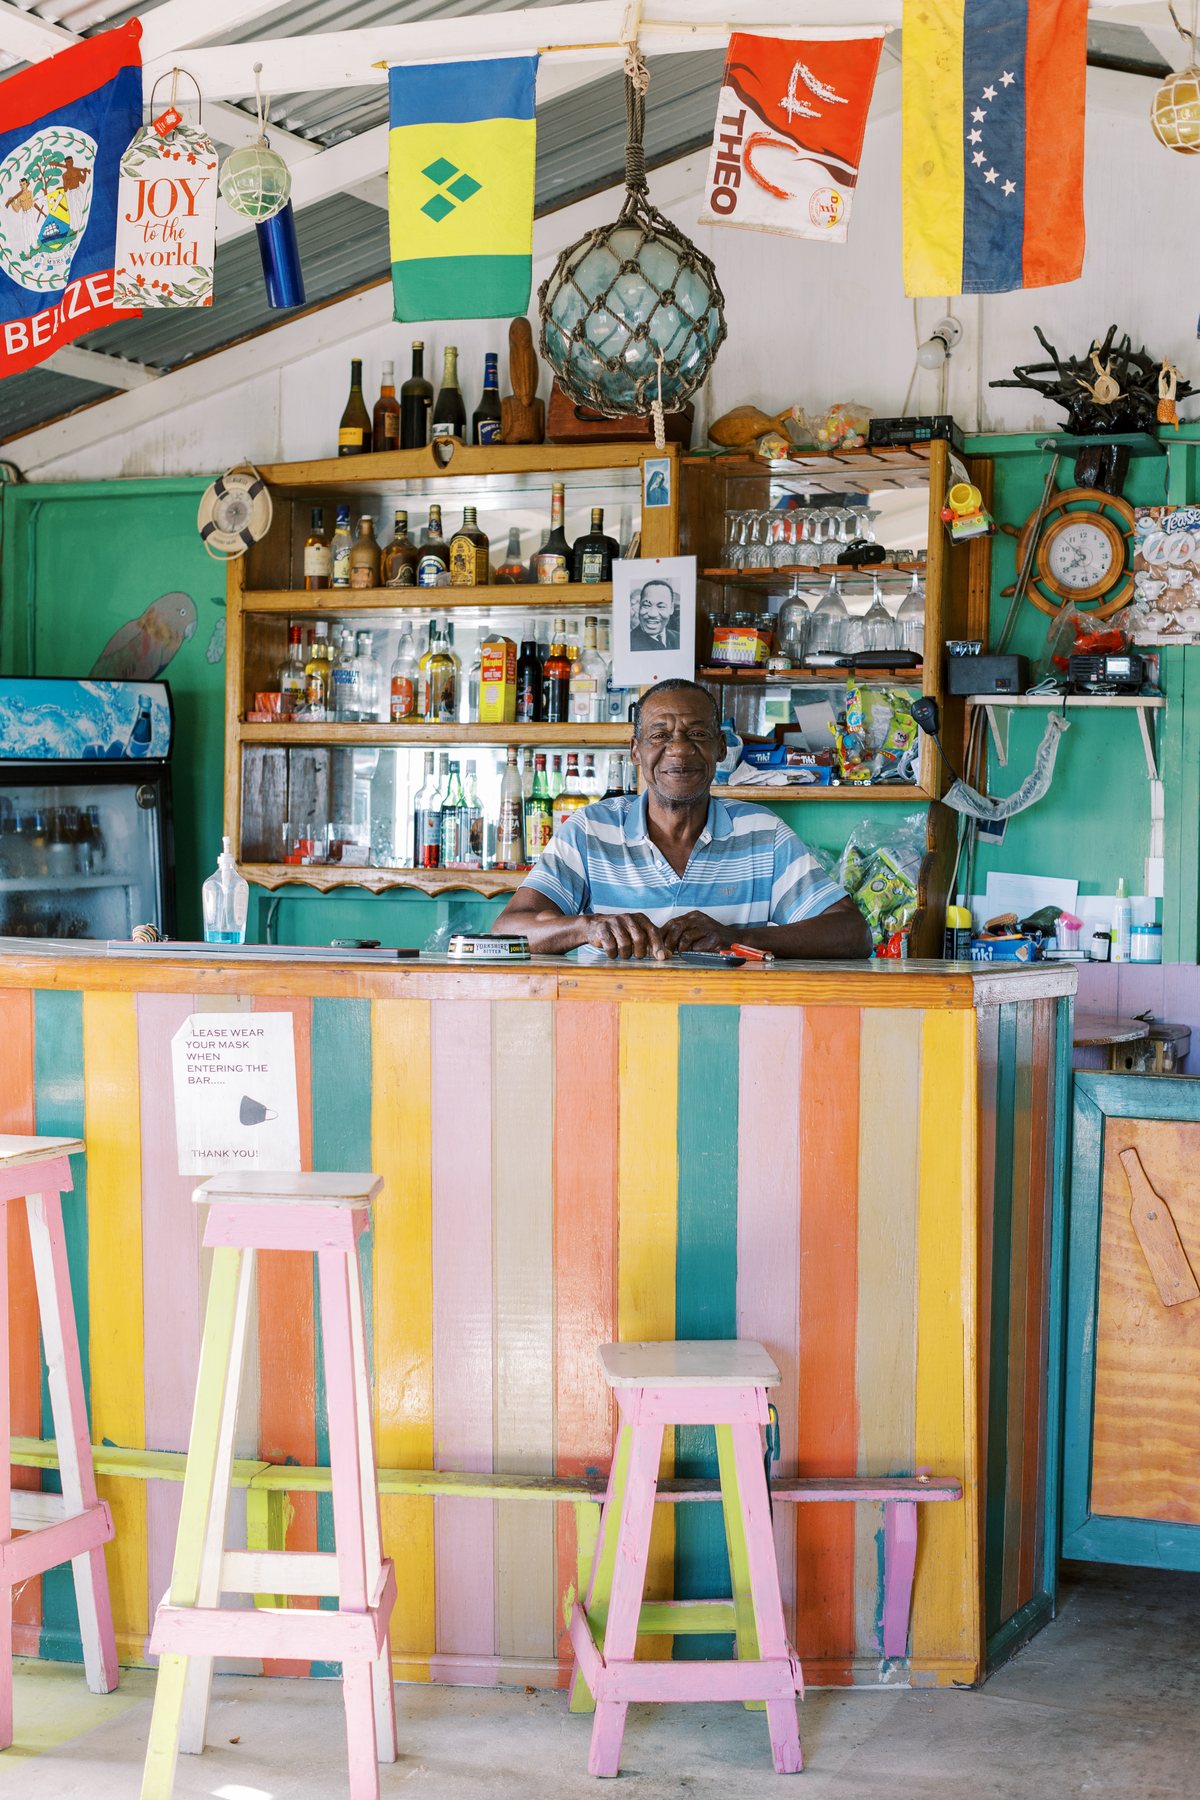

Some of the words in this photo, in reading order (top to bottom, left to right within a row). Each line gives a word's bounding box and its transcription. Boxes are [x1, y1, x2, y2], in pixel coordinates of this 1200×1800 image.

[710, 109, 746, 216] THEO
[125, 177, 210, 223] JOY
[135, 220, 158, 243] to
[162, 217, 186, 243] the
[128, 242, 198, 267] world
[756, 752, 770, 762] Tiki
[800, 754, 816, 764] Tiki
[476, 944, 508, 952] YORKSHIRE
[971, 946, 994, 960] Tiki
[192, 1029, 227, 1037] LEASE
[230, 1028, 264, 1037] WEAR
[186, 1041, 216, 1049] YOUR
[218, 1041, 250, 1049] MASK
[186, 1053, 220, 1061] WHEN
[187, 1064, 244, 1072] ENTERING
[192, 1150, 230, 1158] THANK
[232, 1150, 258, 1158] YOU!
